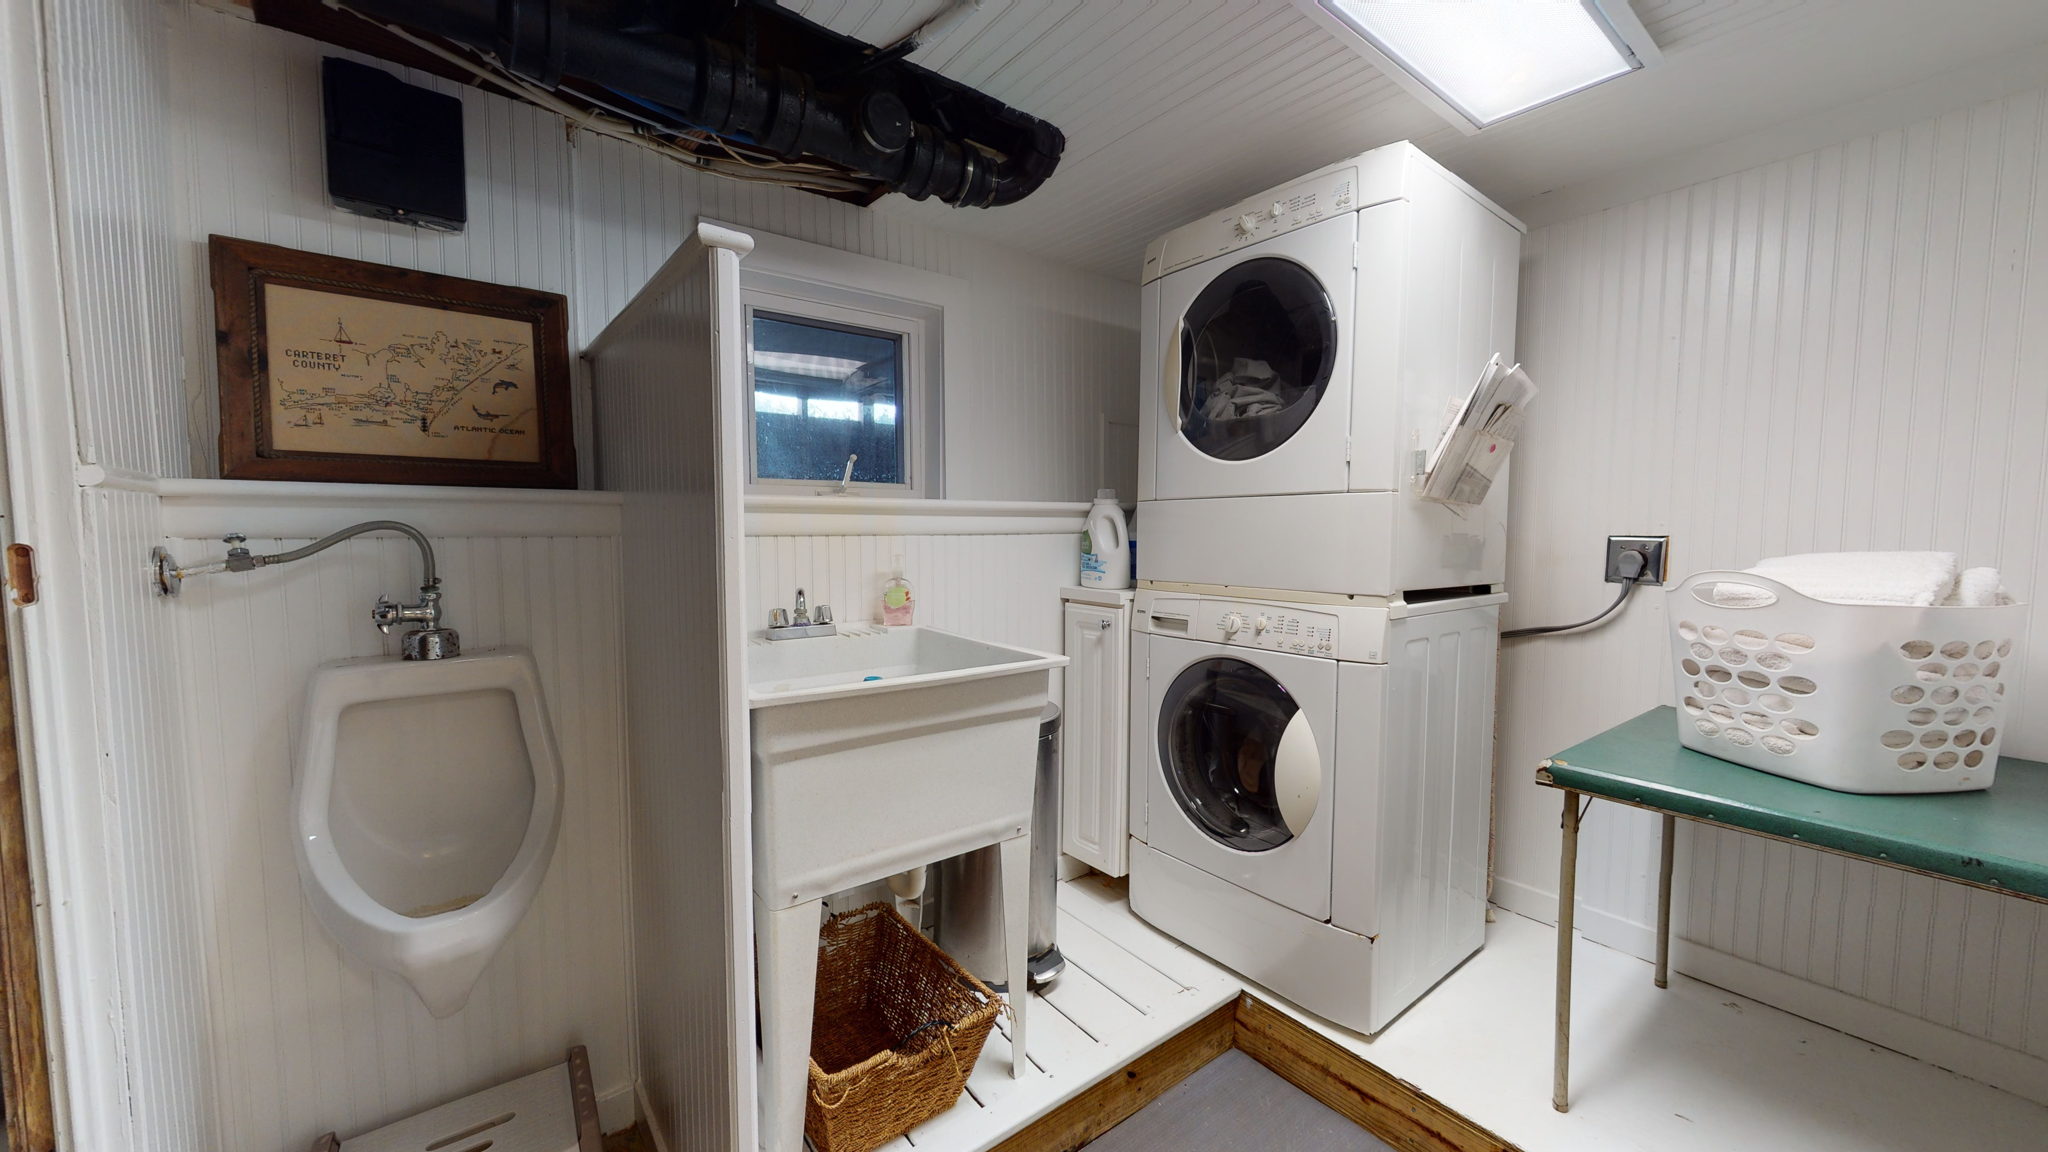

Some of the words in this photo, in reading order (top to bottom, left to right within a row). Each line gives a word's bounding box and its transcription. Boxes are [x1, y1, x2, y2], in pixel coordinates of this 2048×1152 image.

[285, 348, 347, 363] CARTERET
[292, 359, 341, 372] COUNTY
[453, 424, 497, 434] ATLANTIC
[498, 427, 526, 436] OCEAN
